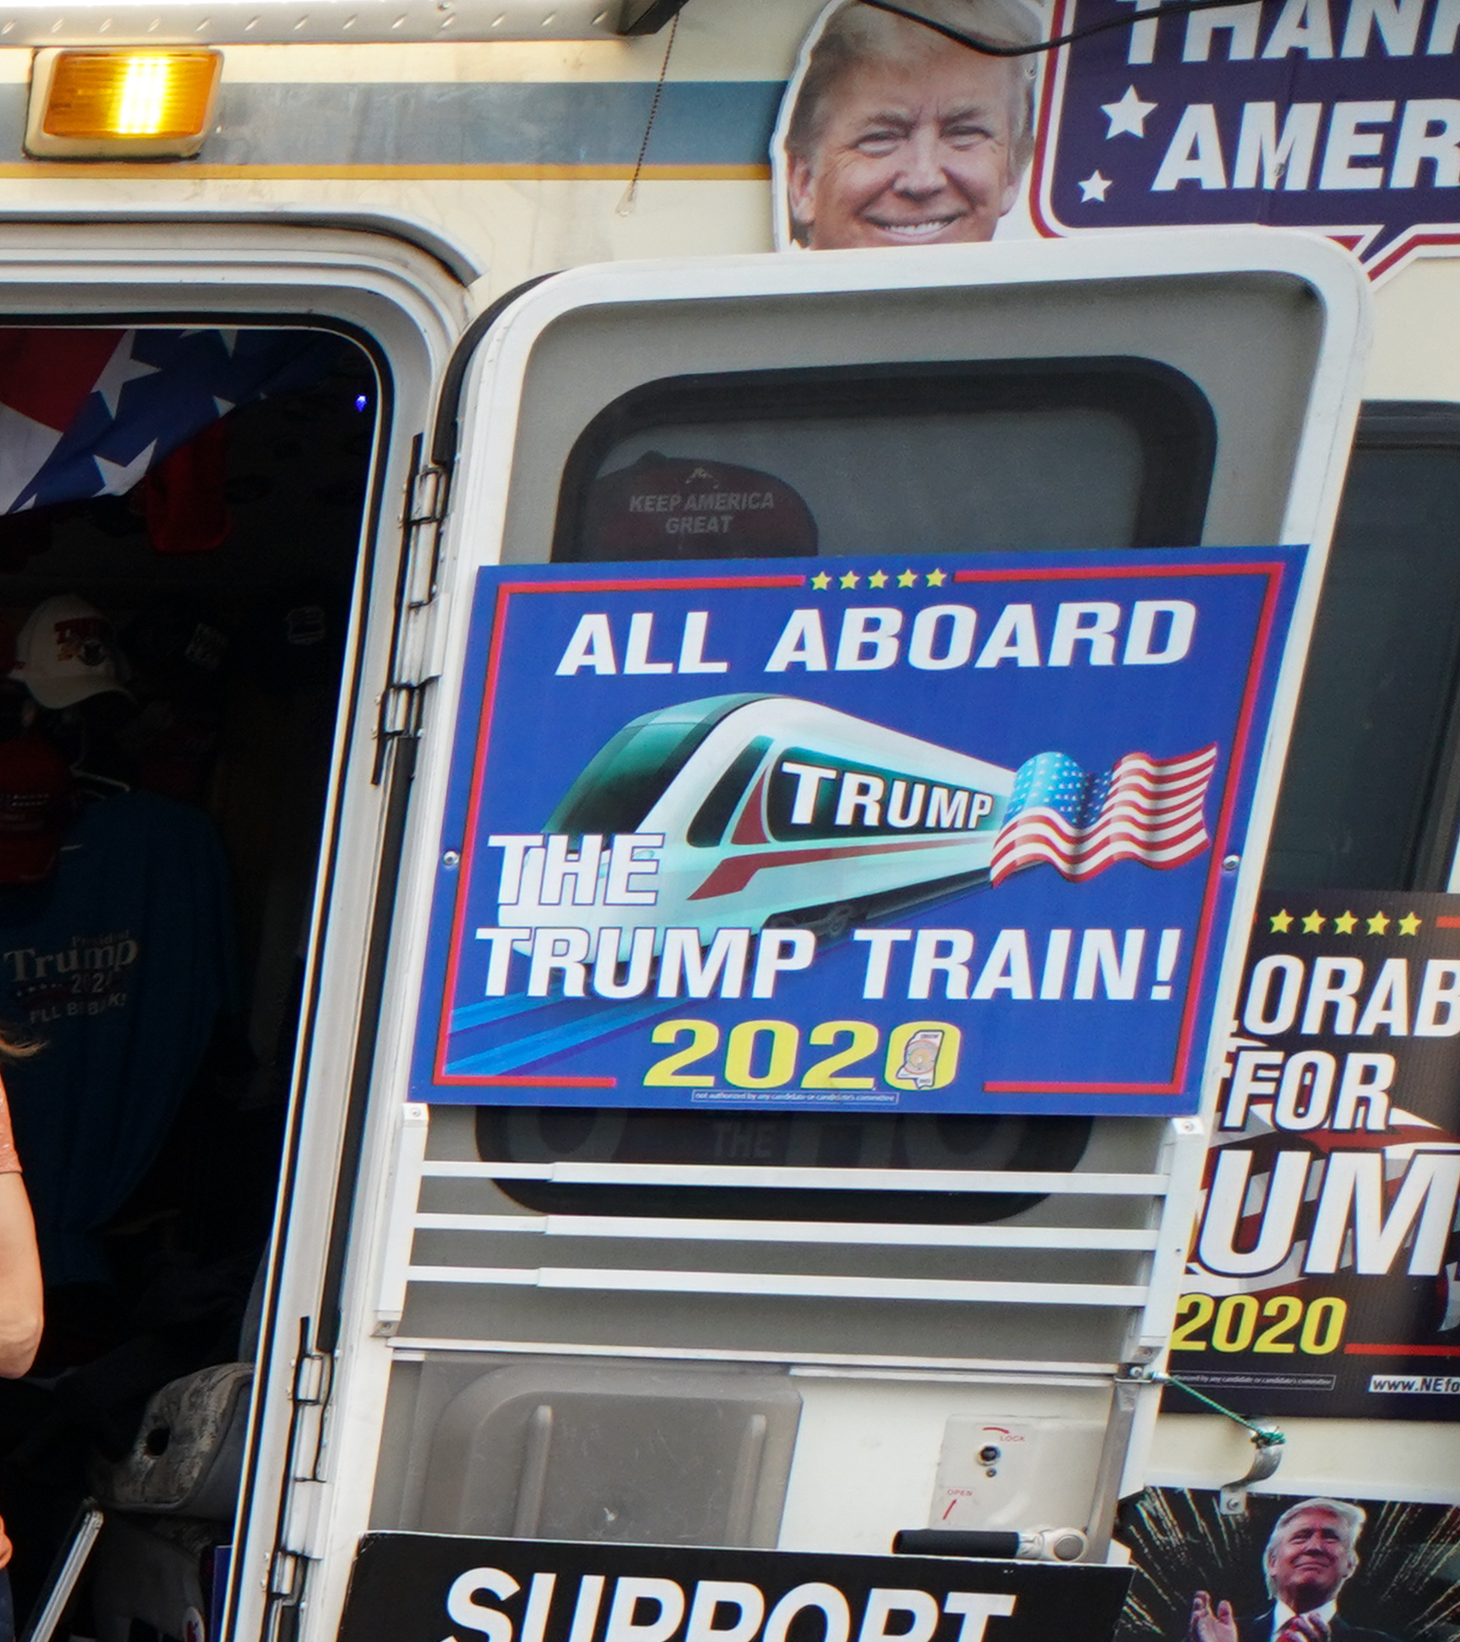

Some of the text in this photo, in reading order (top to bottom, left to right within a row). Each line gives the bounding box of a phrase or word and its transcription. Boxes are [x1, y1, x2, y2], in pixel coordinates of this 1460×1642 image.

[629, 492, 774, 513] KEEP AMERICA
[555, 600, 1198, 677] ALL ABOARD
[780, 760, 995, 832] TRUMP
[487, 832, 666, 907] THE
[475, 926, 1181, 1002] TRUMP TRAIN!
[642, 1019, 962, 1091] 2020
[1224, 1049, 1397, 1132] FOR
[1172, 1293, 1348, 1355] 2020
